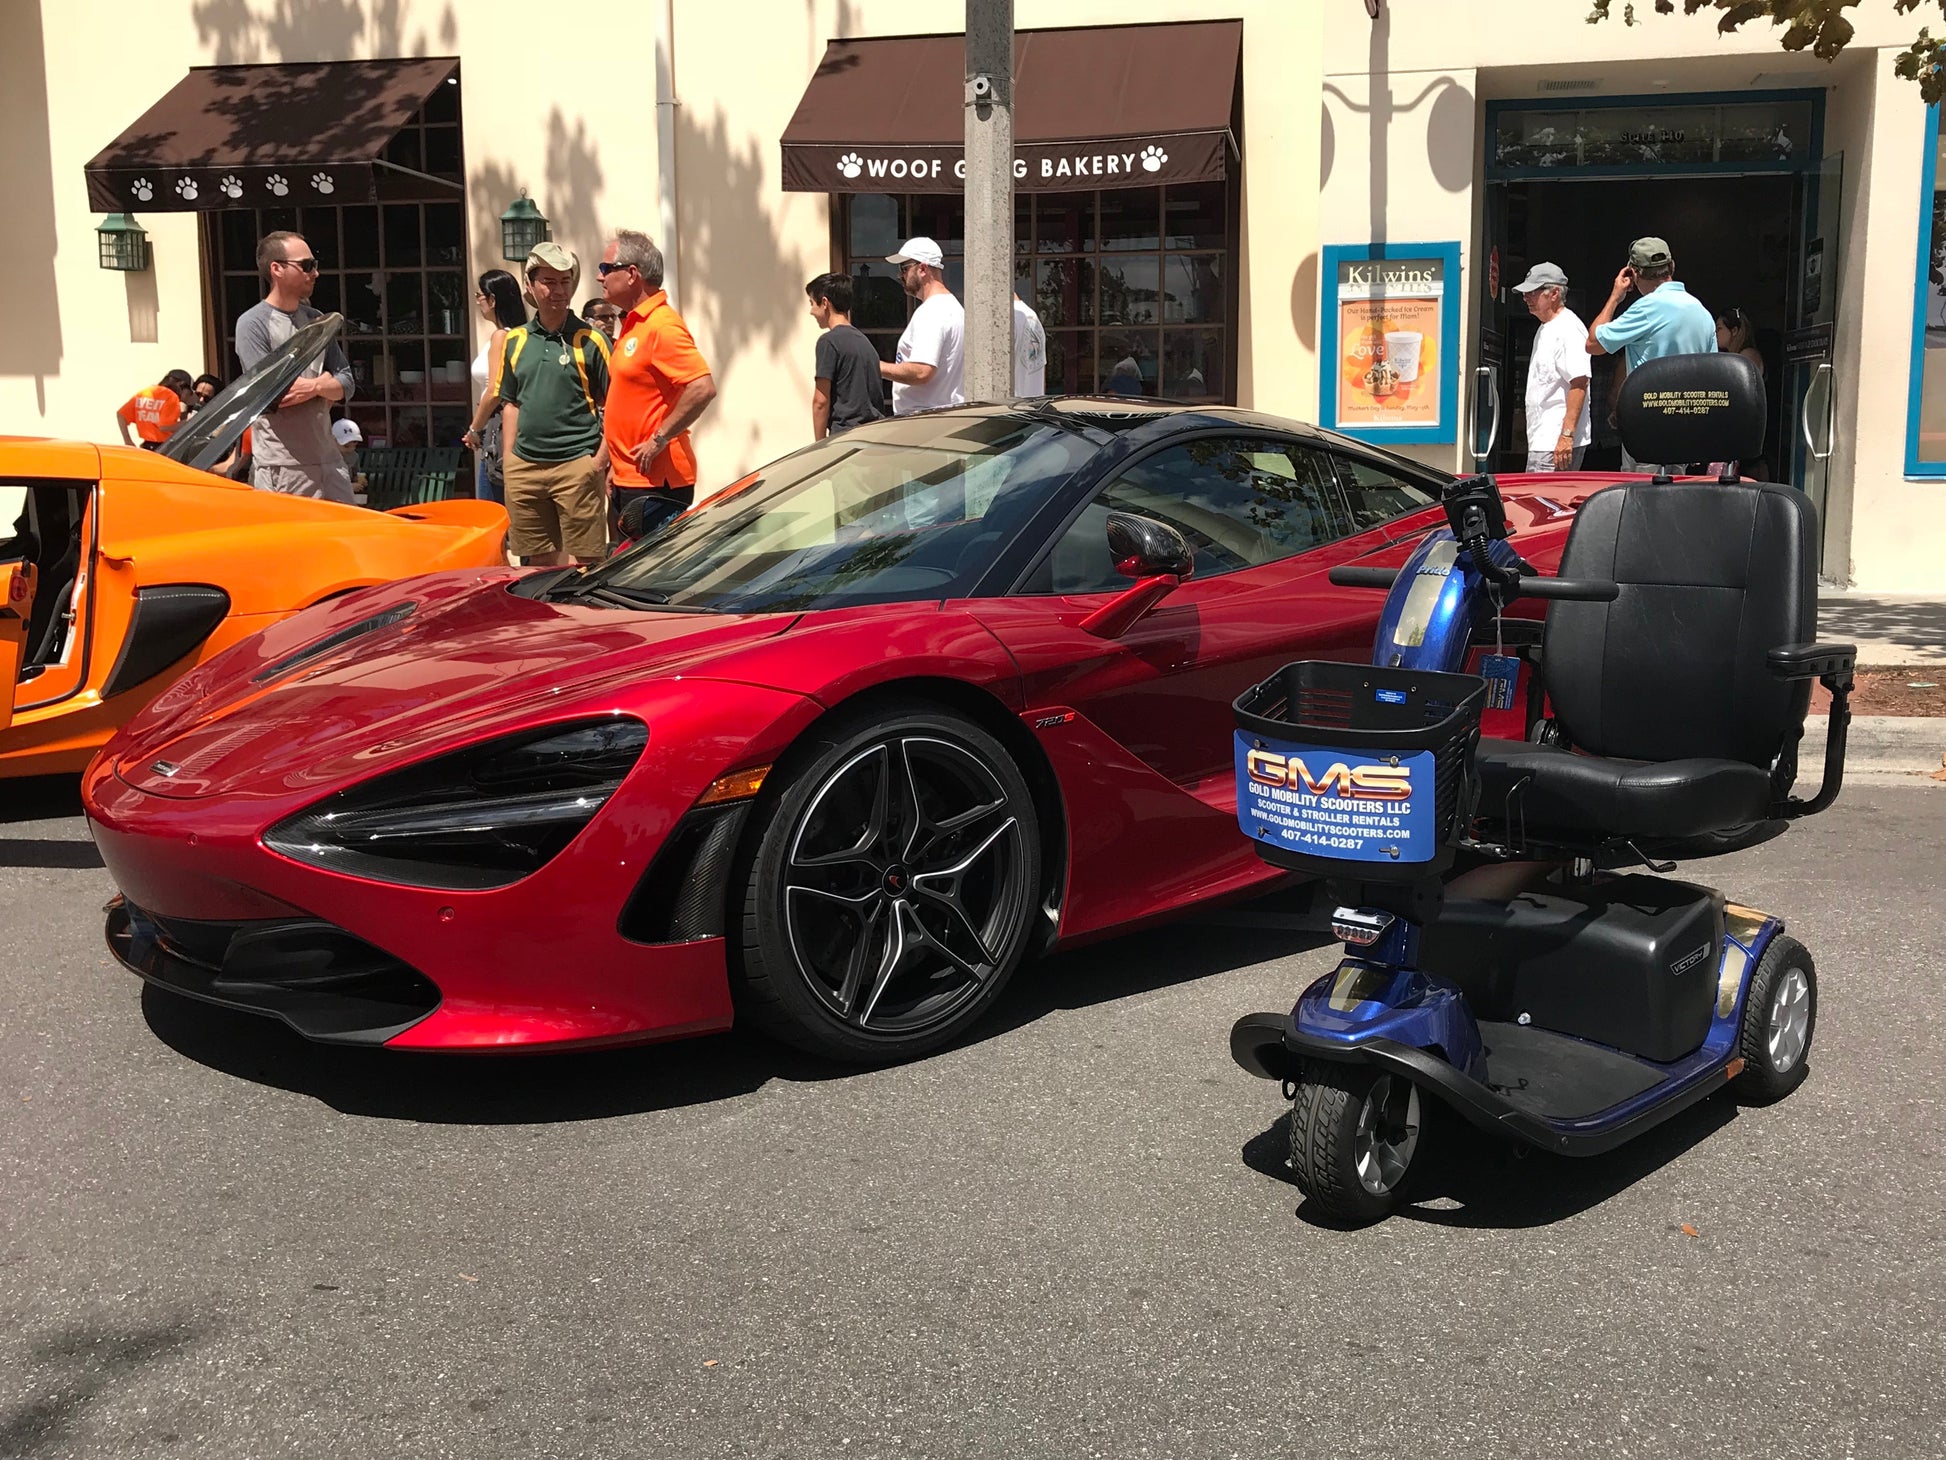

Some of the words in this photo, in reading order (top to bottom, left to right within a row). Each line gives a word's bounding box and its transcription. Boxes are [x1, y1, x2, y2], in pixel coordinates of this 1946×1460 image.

[867, 159, 942, 179] WOOF
[953, 158, 1028, 179] GG
[1041, 153, 1136, 178] BAKERY
[1347, 264, 1434, 285] Kilwins
[1350, 343, 1385, 360] Love
[1642, 399, 1730, 408] WWW.GOLDMOBILITYSCOOTERS.COM
[1643, 392, 1658, 400] GOLD
[1659, 391, 1682, 399] MOBILITY
[1683, 391, 1706, 399] SCOOTER
[1708, 391, 1729, 399] RENTALS
[1035, 712, 1075, 728] 720S
[1247, 749, 1413, 801] GMS
[1248, 781, 1270, 797] GOLD
[1271, 787, 1319, 808] MOBILITY
[1320, 797, 1384, 814] SCOOTERS
[1387, 802, 1411, 815] LLC
[1250, 807, 1410, 839] WWW.GOLDMOBILITYSCOOTERS.COM
[1257, 798, 1291, 815] SCOOTER
[1293, 807, 1300, 817] &
[1302, 809, 1350, 824] STROLLER
[1352, 815, 1400, 827] RENTALS
[1281, 828, 1364, 850] 407-414-0287
[1674, 949, 1703, 973] VICTORY
